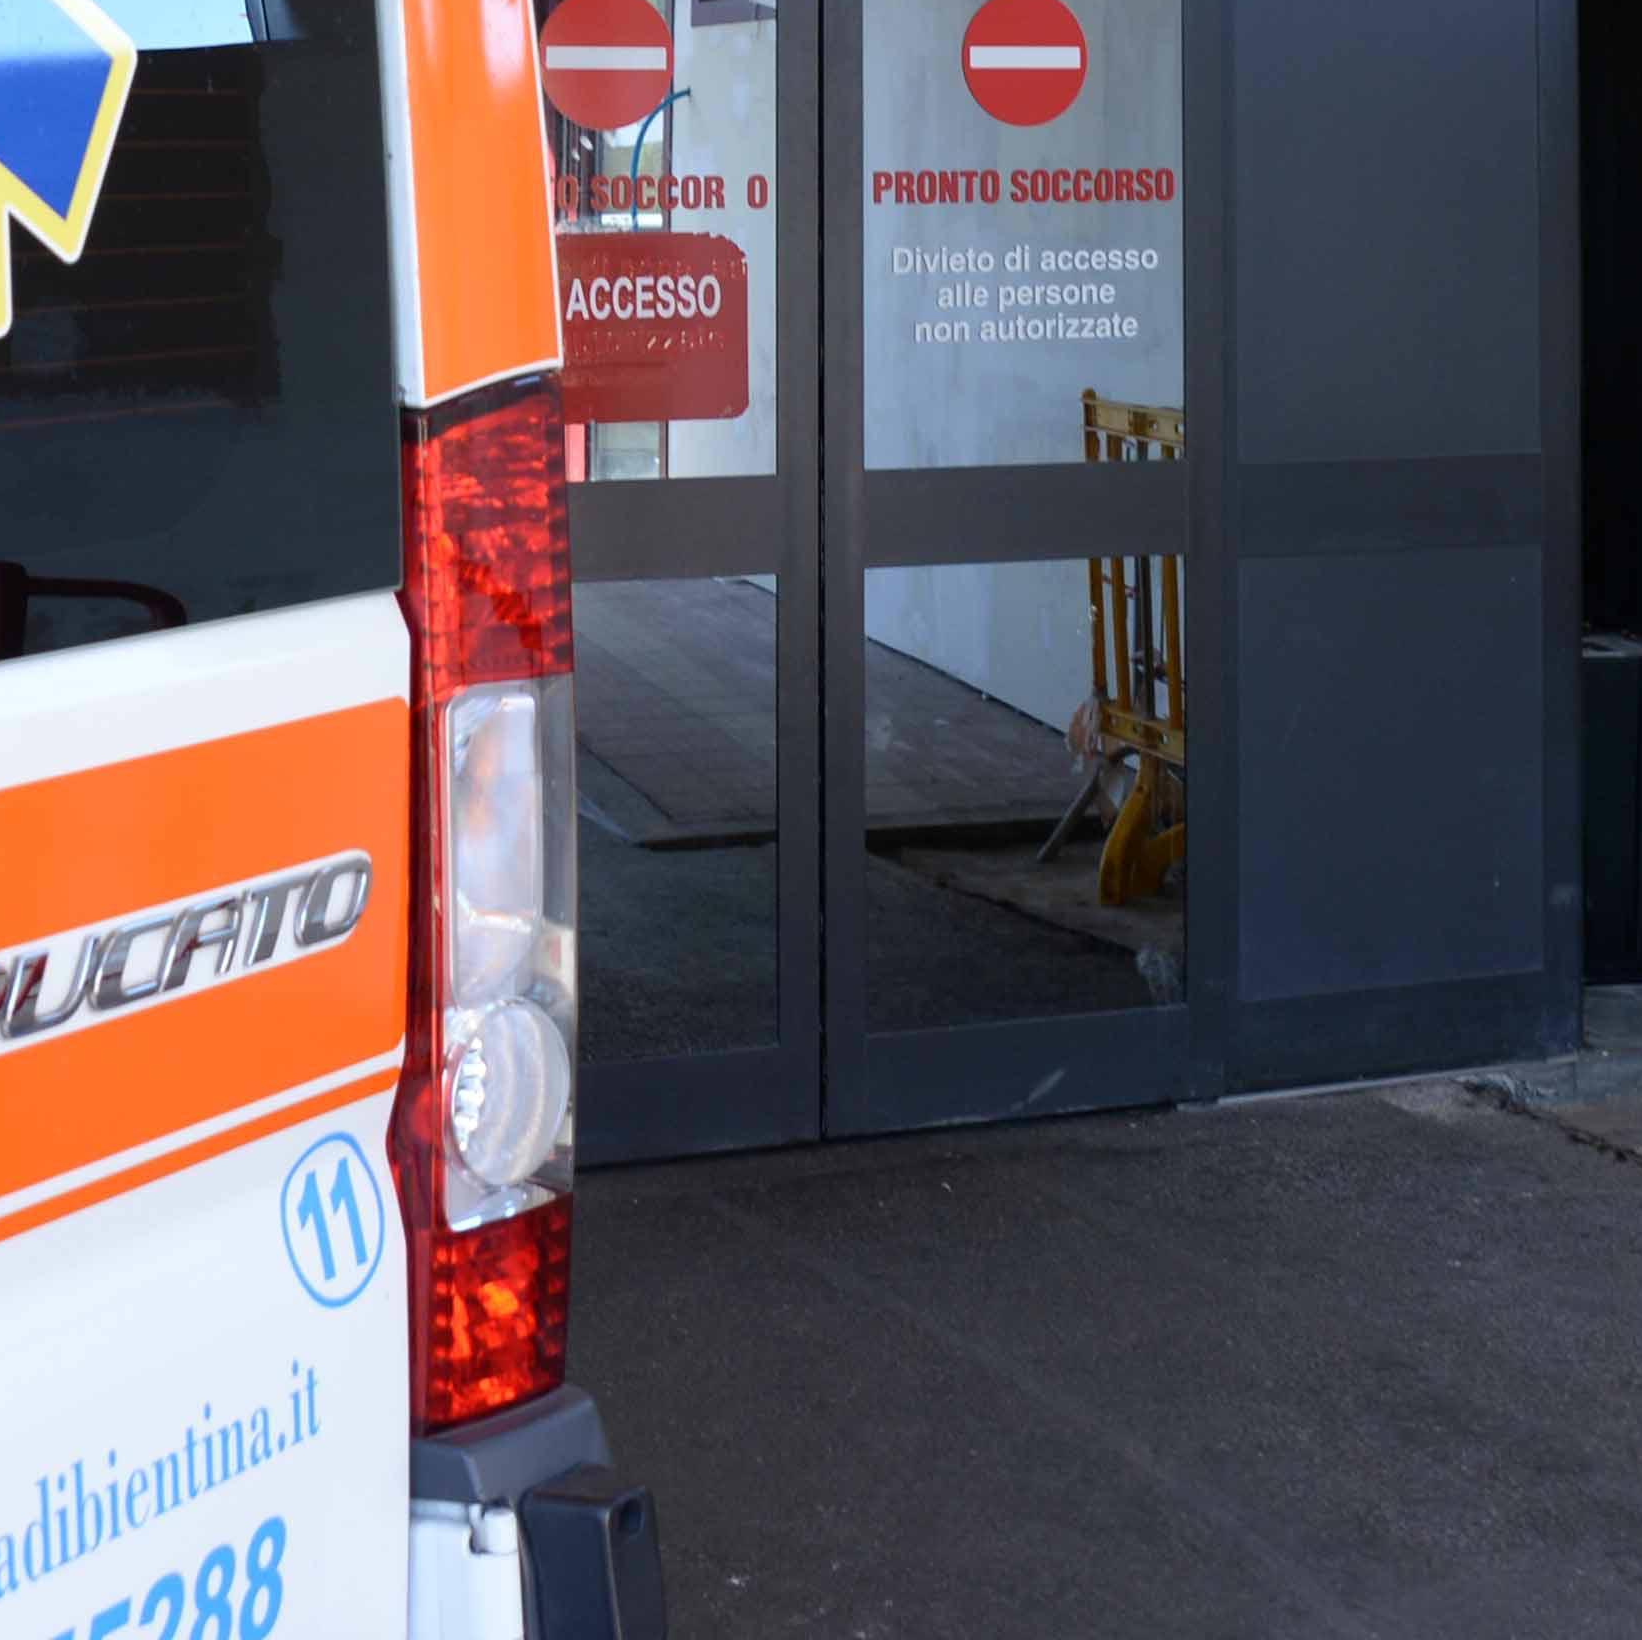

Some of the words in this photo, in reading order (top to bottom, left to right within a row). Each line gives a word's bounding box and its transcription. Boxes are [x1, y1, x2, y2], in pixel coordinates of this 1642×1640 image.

[871, 169, 1001, 205] PRONTO
[1009, 167, 1175, 203] SOCCORSO
[890, 245, 995, 275] Divieto
[1003, 244, 1031, 272] di
[1039, 247, 1159, 273] accesso
[564, 274, 722, 321] ACCESSO
[936, 280, 990, 310] alle
[997, 281, 1117, 313] persone
[913, 319, 971, 344] non
[979, 311, 1140, 343] autorizzate
[296, 1155, 371, 1283] 11
